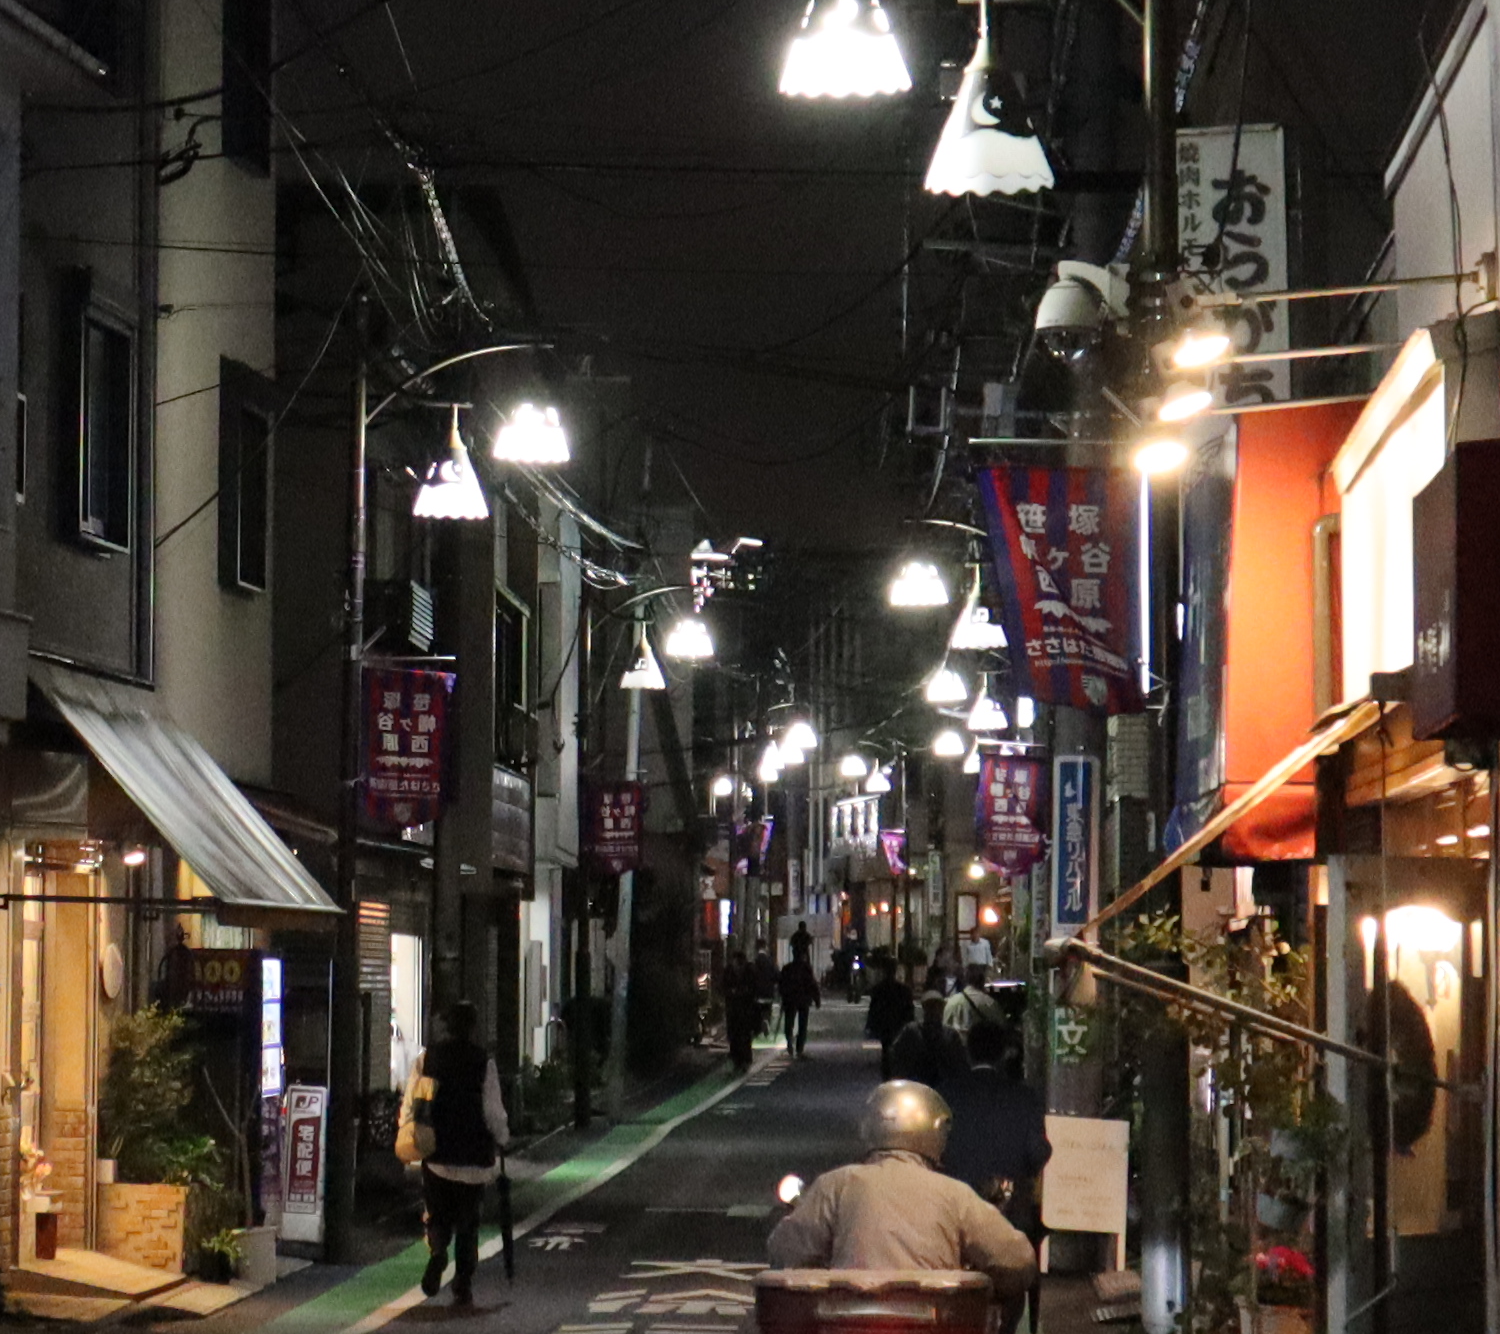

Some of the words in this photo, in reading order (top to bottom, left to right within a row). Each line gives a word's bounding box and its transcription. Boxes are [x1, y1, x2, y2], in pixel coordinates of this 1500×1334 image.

[1179, 142, 1205, 277] 焼肉ホルモ
